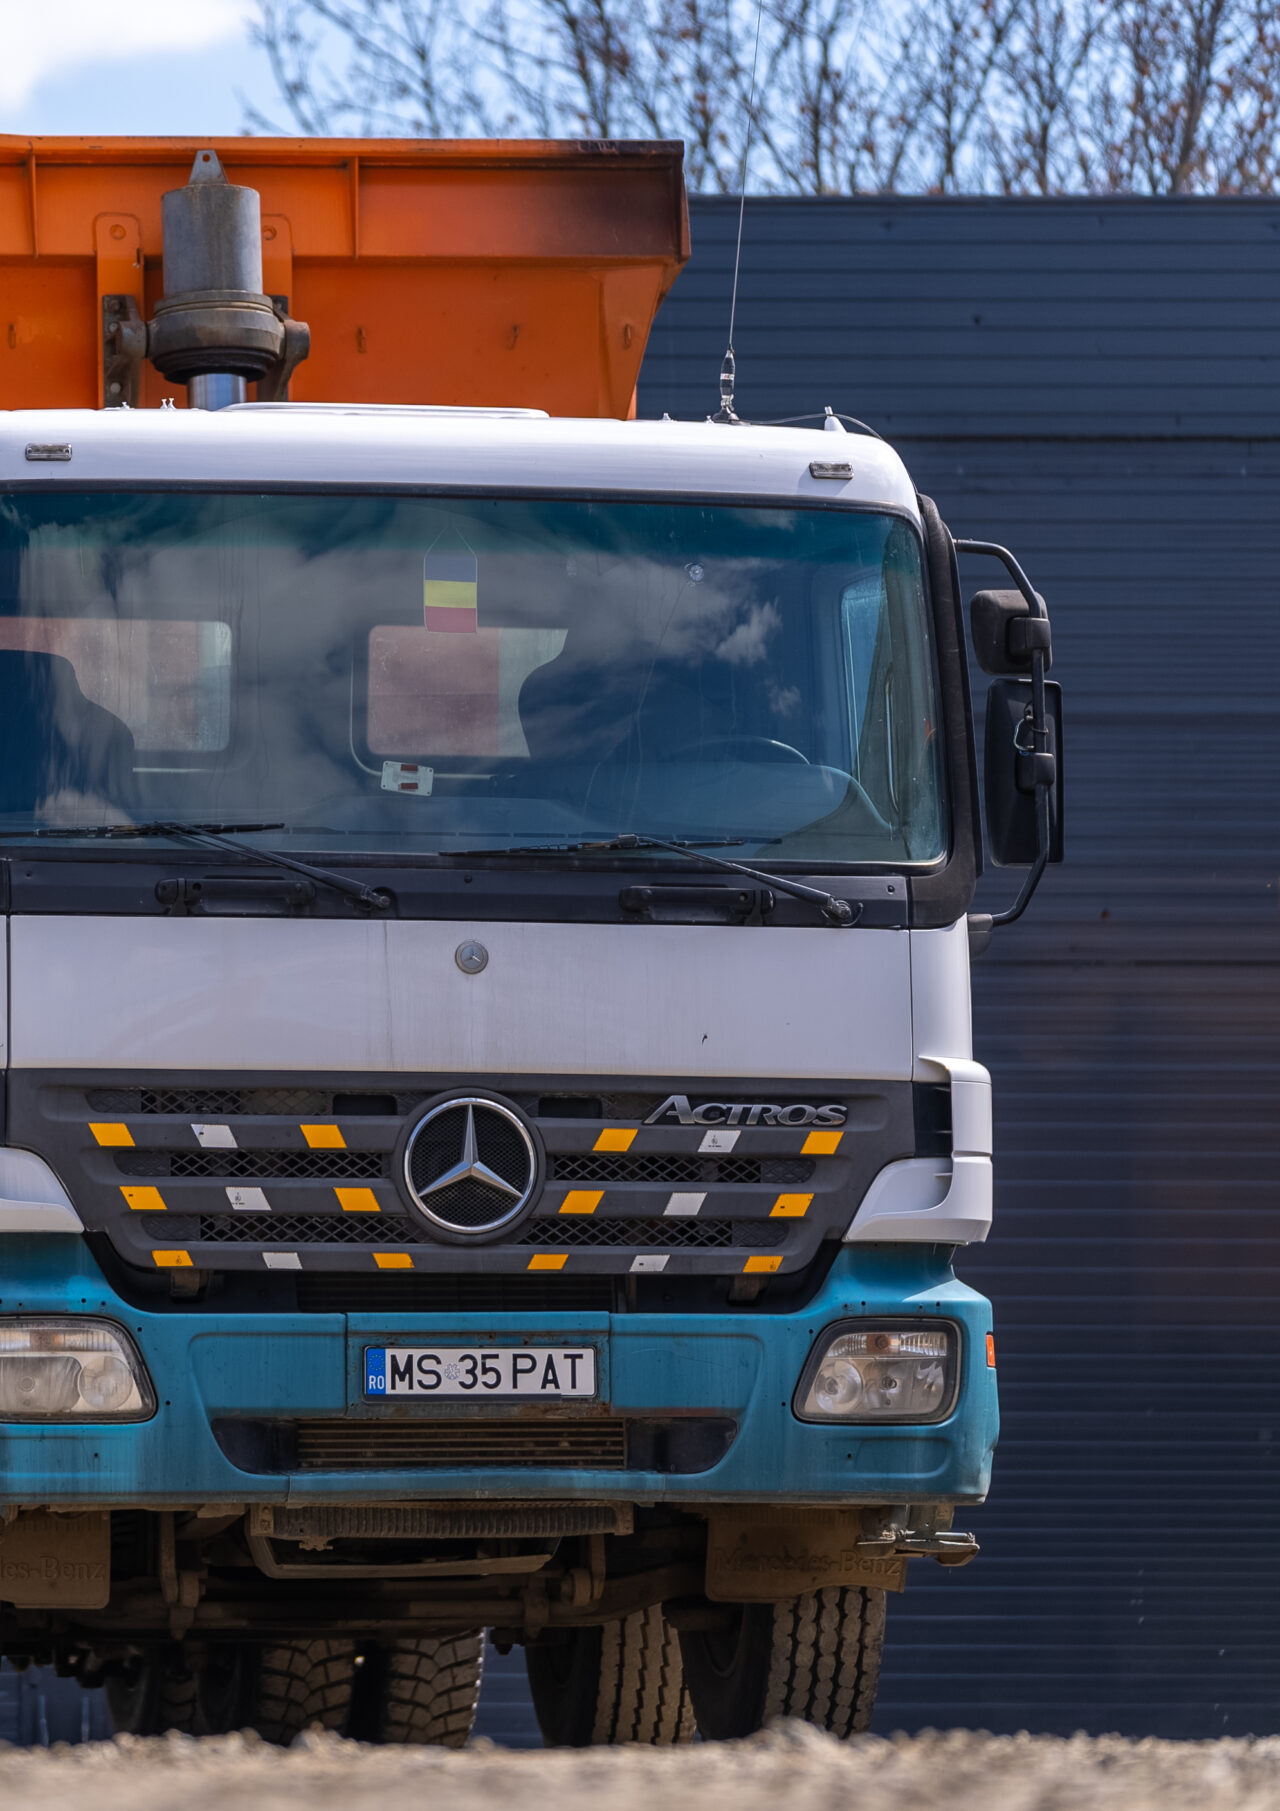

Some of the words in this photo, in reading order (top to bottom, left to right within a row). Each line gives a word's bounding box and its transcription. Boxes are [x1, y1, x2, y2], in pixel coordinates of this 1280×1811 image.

[644, 1095, 848, 1126] ACTROS
[368, 1375, 385, 1390] RO
[390, 1353, 442, 1390] MS
[458, 1353, 502, 1390] 35
[512, 1353, 583, 1390] PAT
